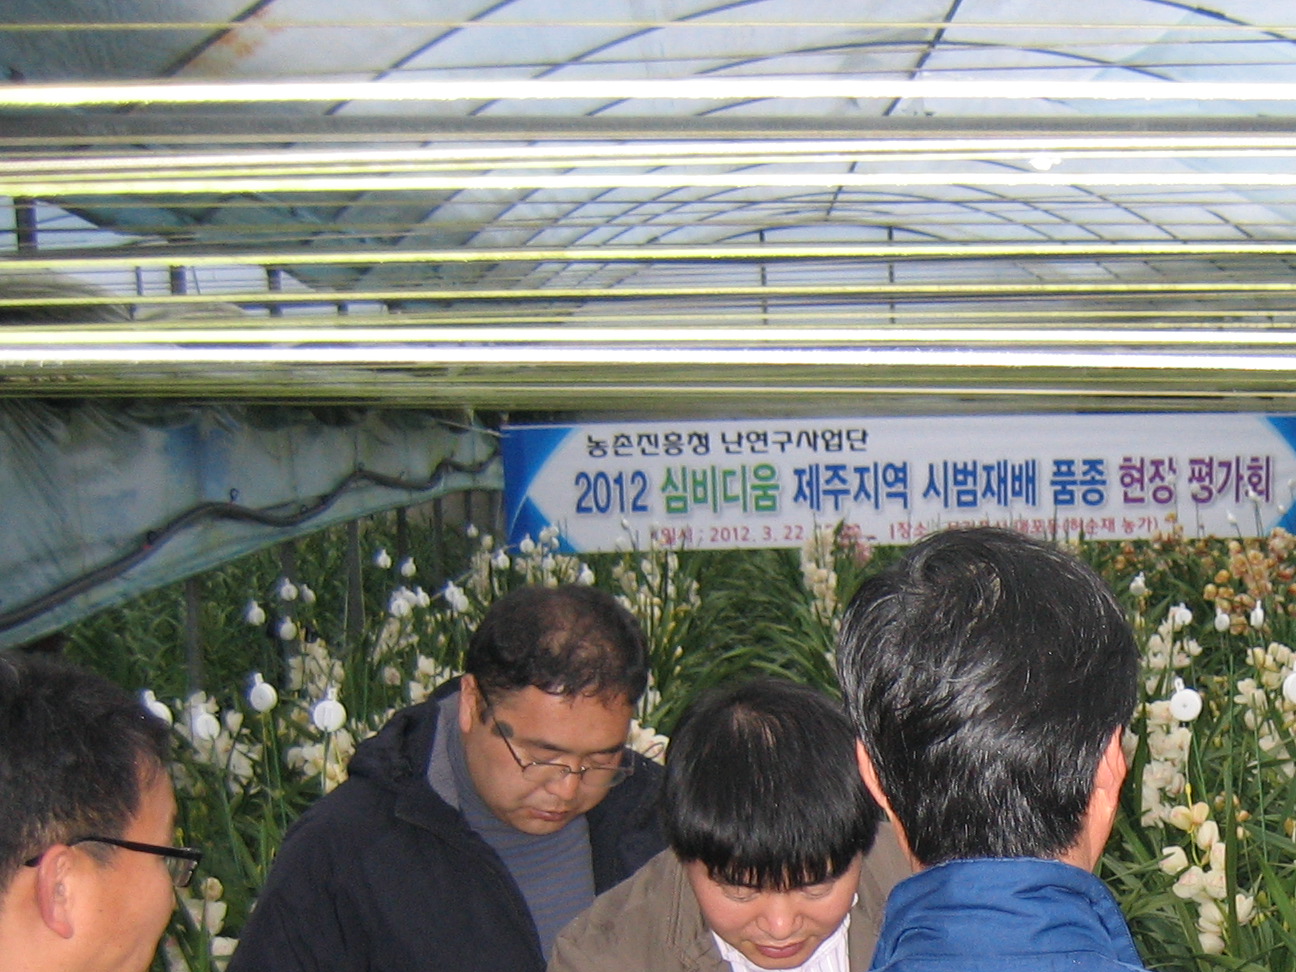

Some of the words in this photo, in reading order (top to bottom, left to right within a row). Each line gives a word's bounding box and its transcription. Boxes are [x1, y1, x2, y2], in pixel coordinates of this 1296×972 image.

[586, 430, 711, 458] 농촌진흥청
[720, 429, 870, 455] 난연구사업단
[573, 470, 649, 514] 2012
[660, 462, 780, 514] 심비디움
[792, 461, 911, 512] 제주지역
[922, 459, 1038, 509] 시범재배
[1049, 458, 1109, 508] 품종
[1118, 455, 1178, 505] 현장
[1188, 455, 1273, 505] 평가회
